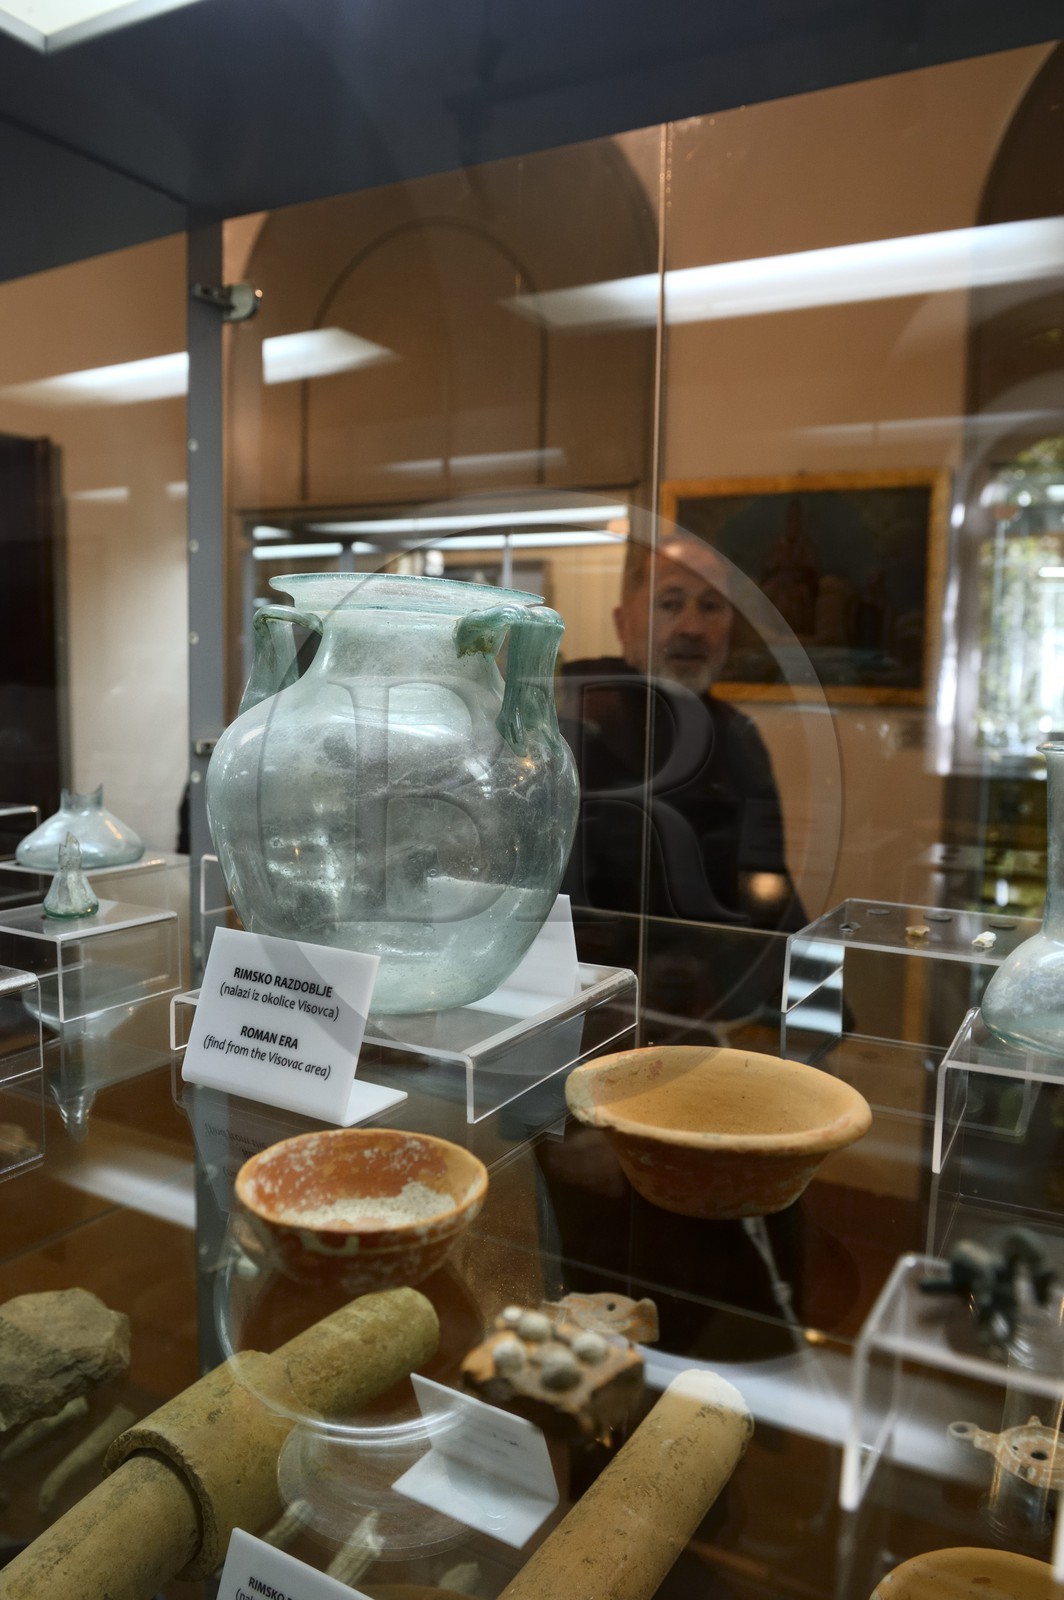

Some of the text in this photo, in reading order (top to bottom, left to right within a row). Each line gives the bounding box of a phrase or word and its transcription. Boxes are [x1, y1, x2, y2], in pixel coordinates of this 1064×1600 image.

[233, 967, 333, 998] RIMSKO RAZDOBLJE
[220, 981, 340, 1022] (nalazi iz okolice Visovca)
[240, 1025, 299, 1049] ROMAN ERA
[203, 1034, 331, 1081] (find from the Visovac area)
